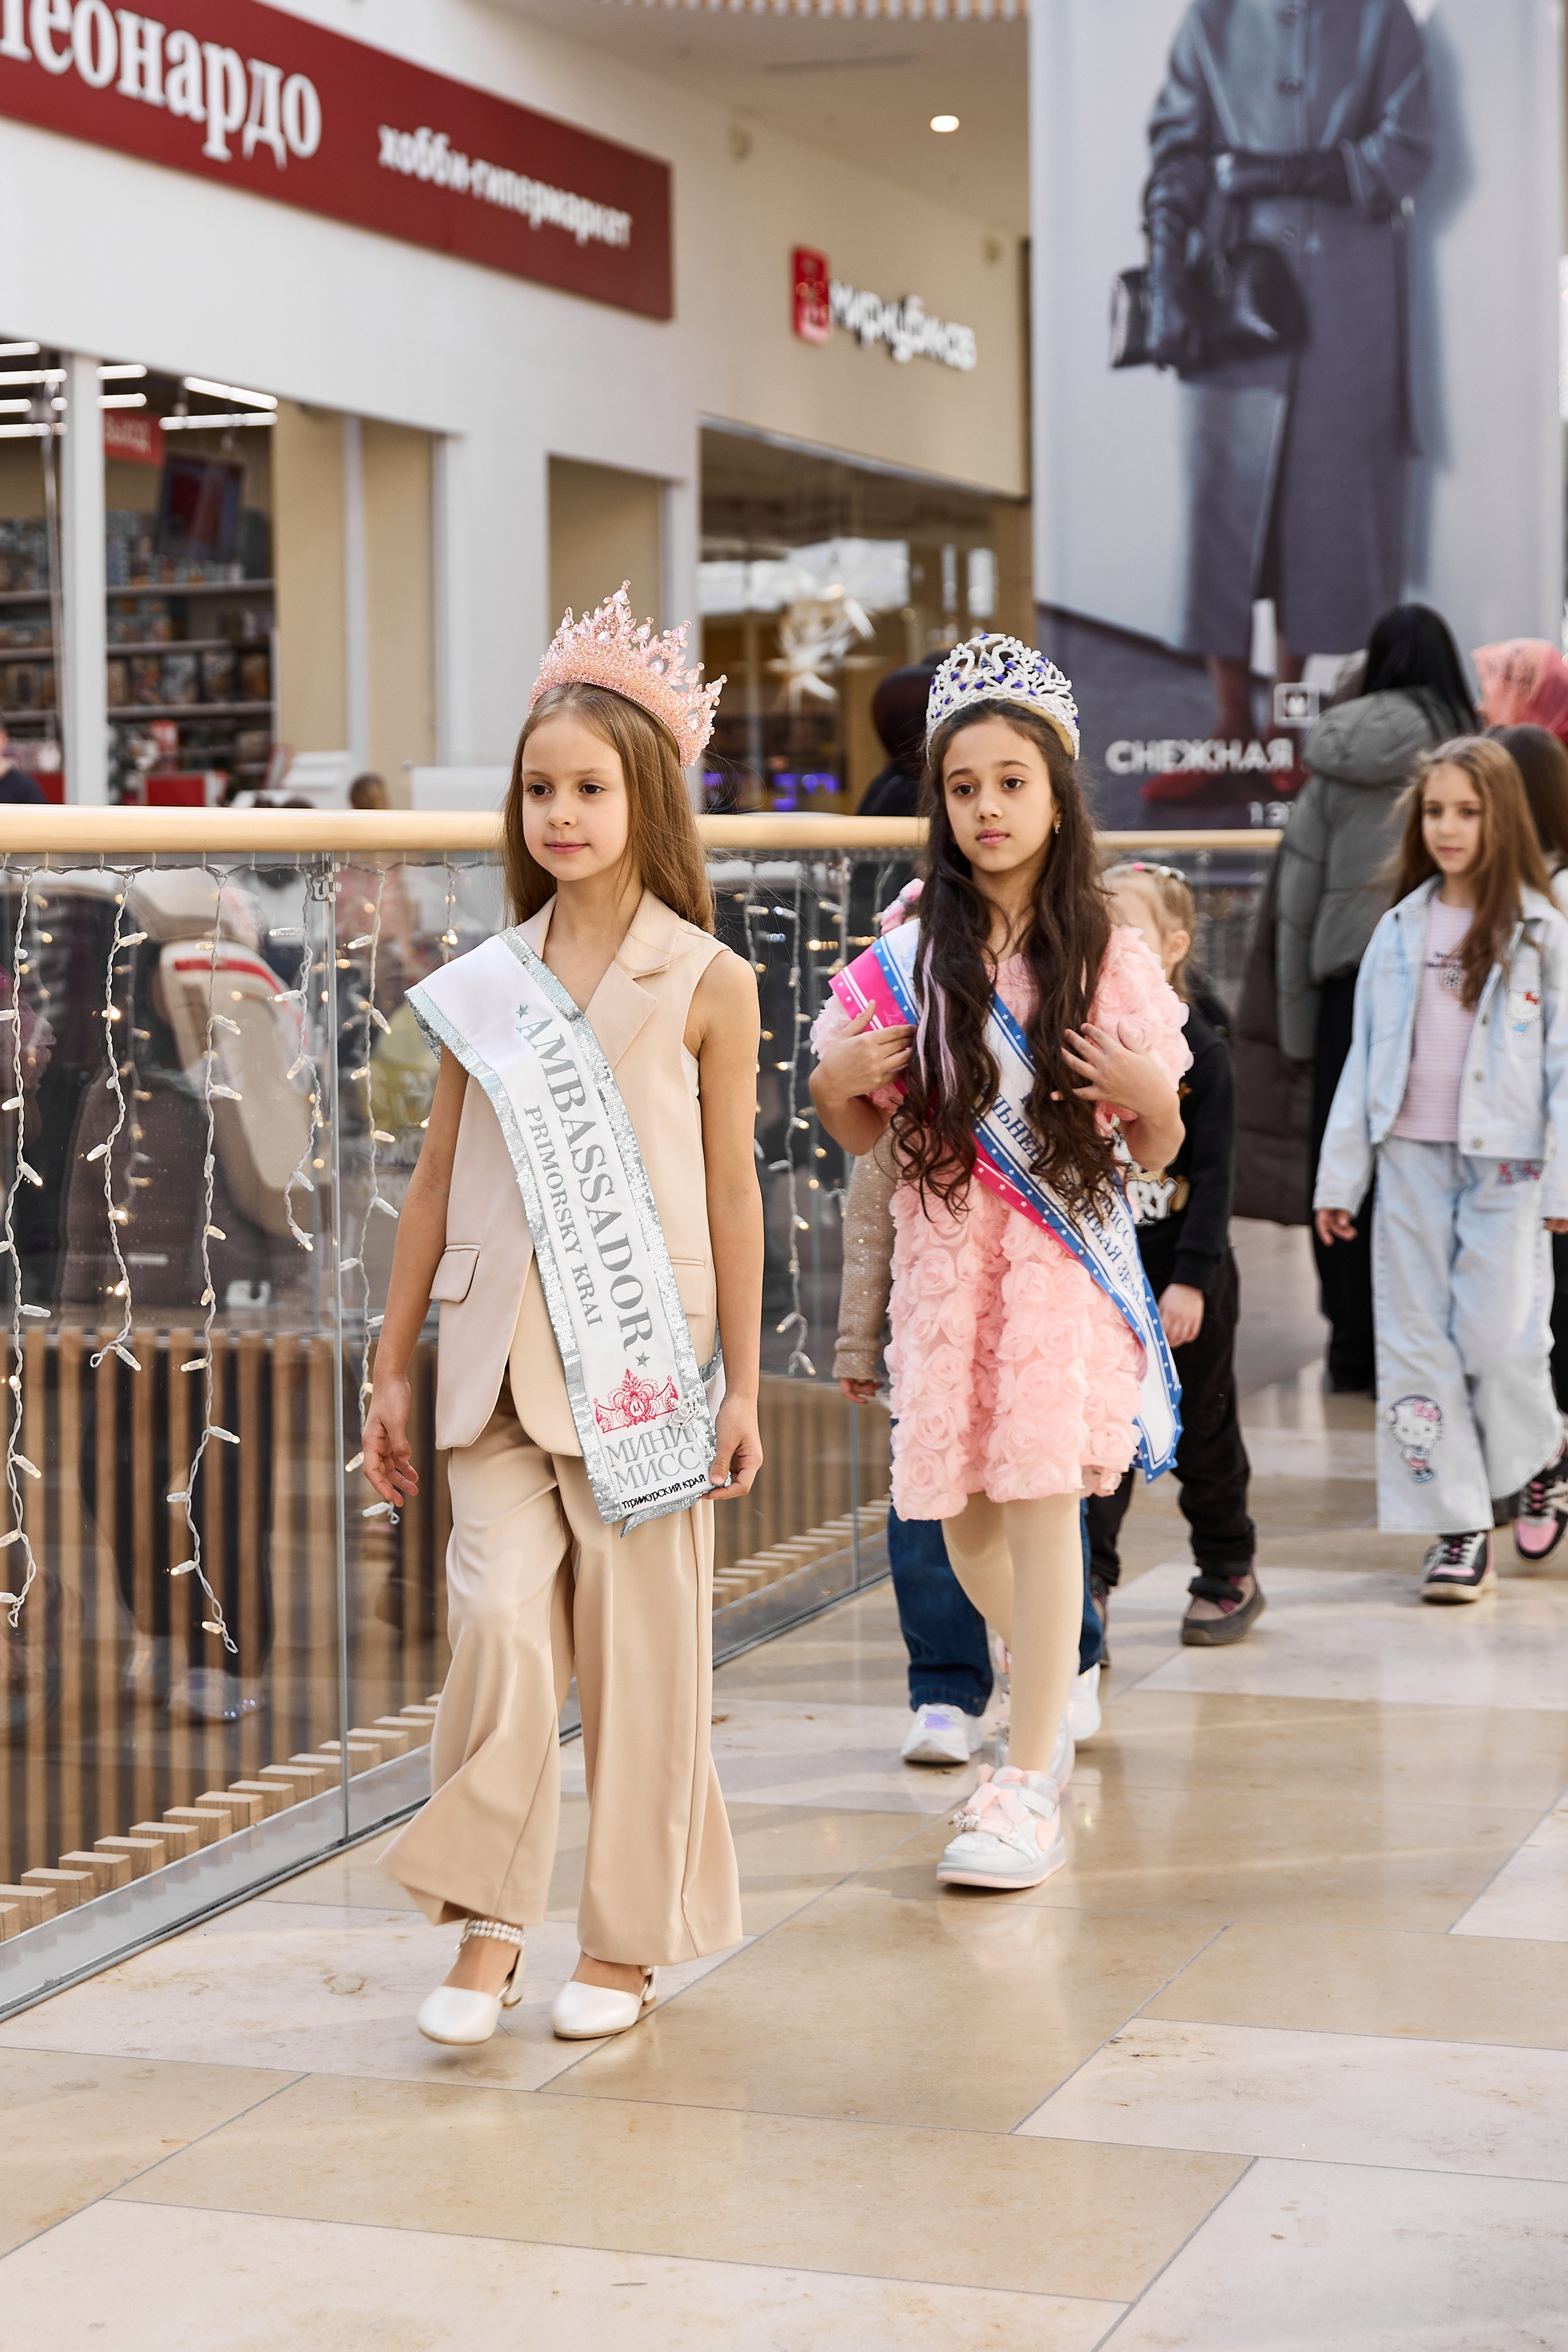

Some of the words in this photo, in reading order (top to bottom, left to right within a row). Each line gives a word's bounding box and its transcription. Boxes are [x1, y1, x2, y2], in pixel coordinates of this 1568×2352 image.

[1105, 738, 1294, 774] СНЕЖНАЯ
[515, 1018, 654, 1352] AMBASSADOR
[1126, 1177, 1180, 1224] RY
[524, 1104, 582, 1255] PRIMORSKY
[571, 1263, 603, 1327] KRAI
[605, 1425, 695, 1468] МИНИ
[613, 1446, 701, 1493] МИСС
